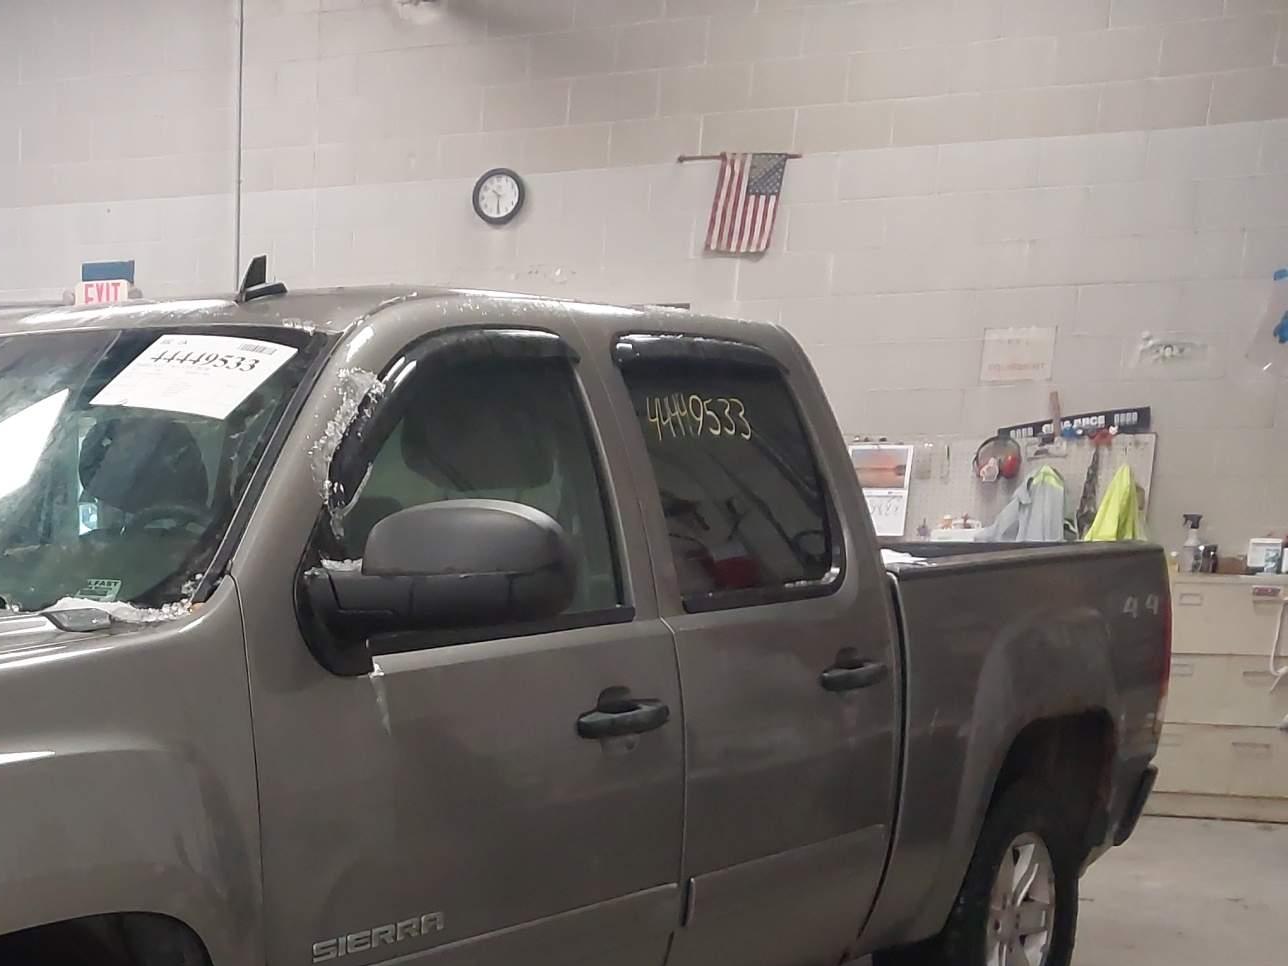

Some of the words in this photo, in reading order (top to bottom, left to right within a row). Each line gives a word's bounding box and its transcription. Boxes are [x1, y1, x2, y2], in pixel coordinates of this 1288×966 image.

[85, 282, 120, 304] EXIT
[151, 349, 260, 372] 44449533
[312, 911, 445, 963] SIERRA
